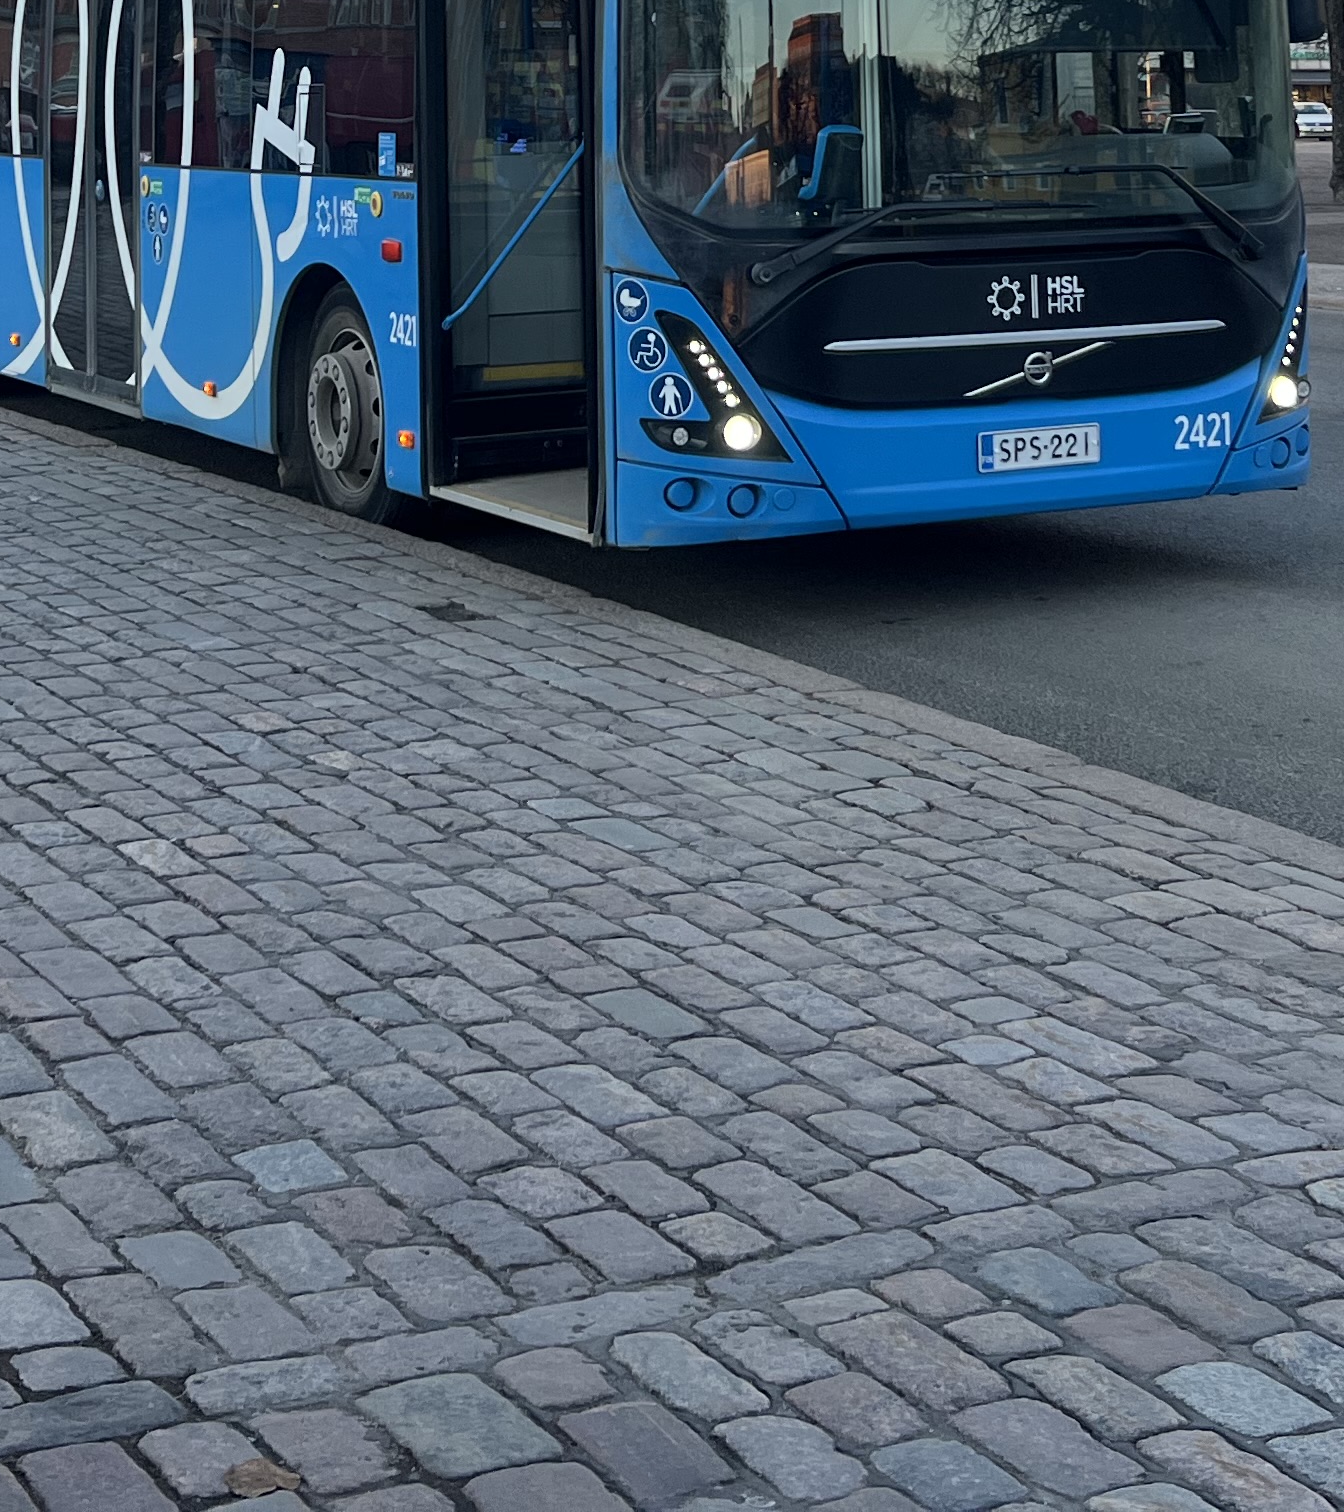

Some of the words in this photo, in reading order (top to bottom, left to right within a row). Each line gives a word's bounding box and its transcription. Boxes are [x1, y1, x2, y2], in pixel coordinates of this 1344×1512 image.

[340, 199, 358, 218] HSL
[340, 218, 358, 237] HRT
[1047, 275, 1085, 295] HSL
[1047, 294, 1086, 315] HRT
[389, 311, 417, 348] 2421
[1174, 411, 1231, 450] 2421
[999, 431, 1089, 463] SPS-221
